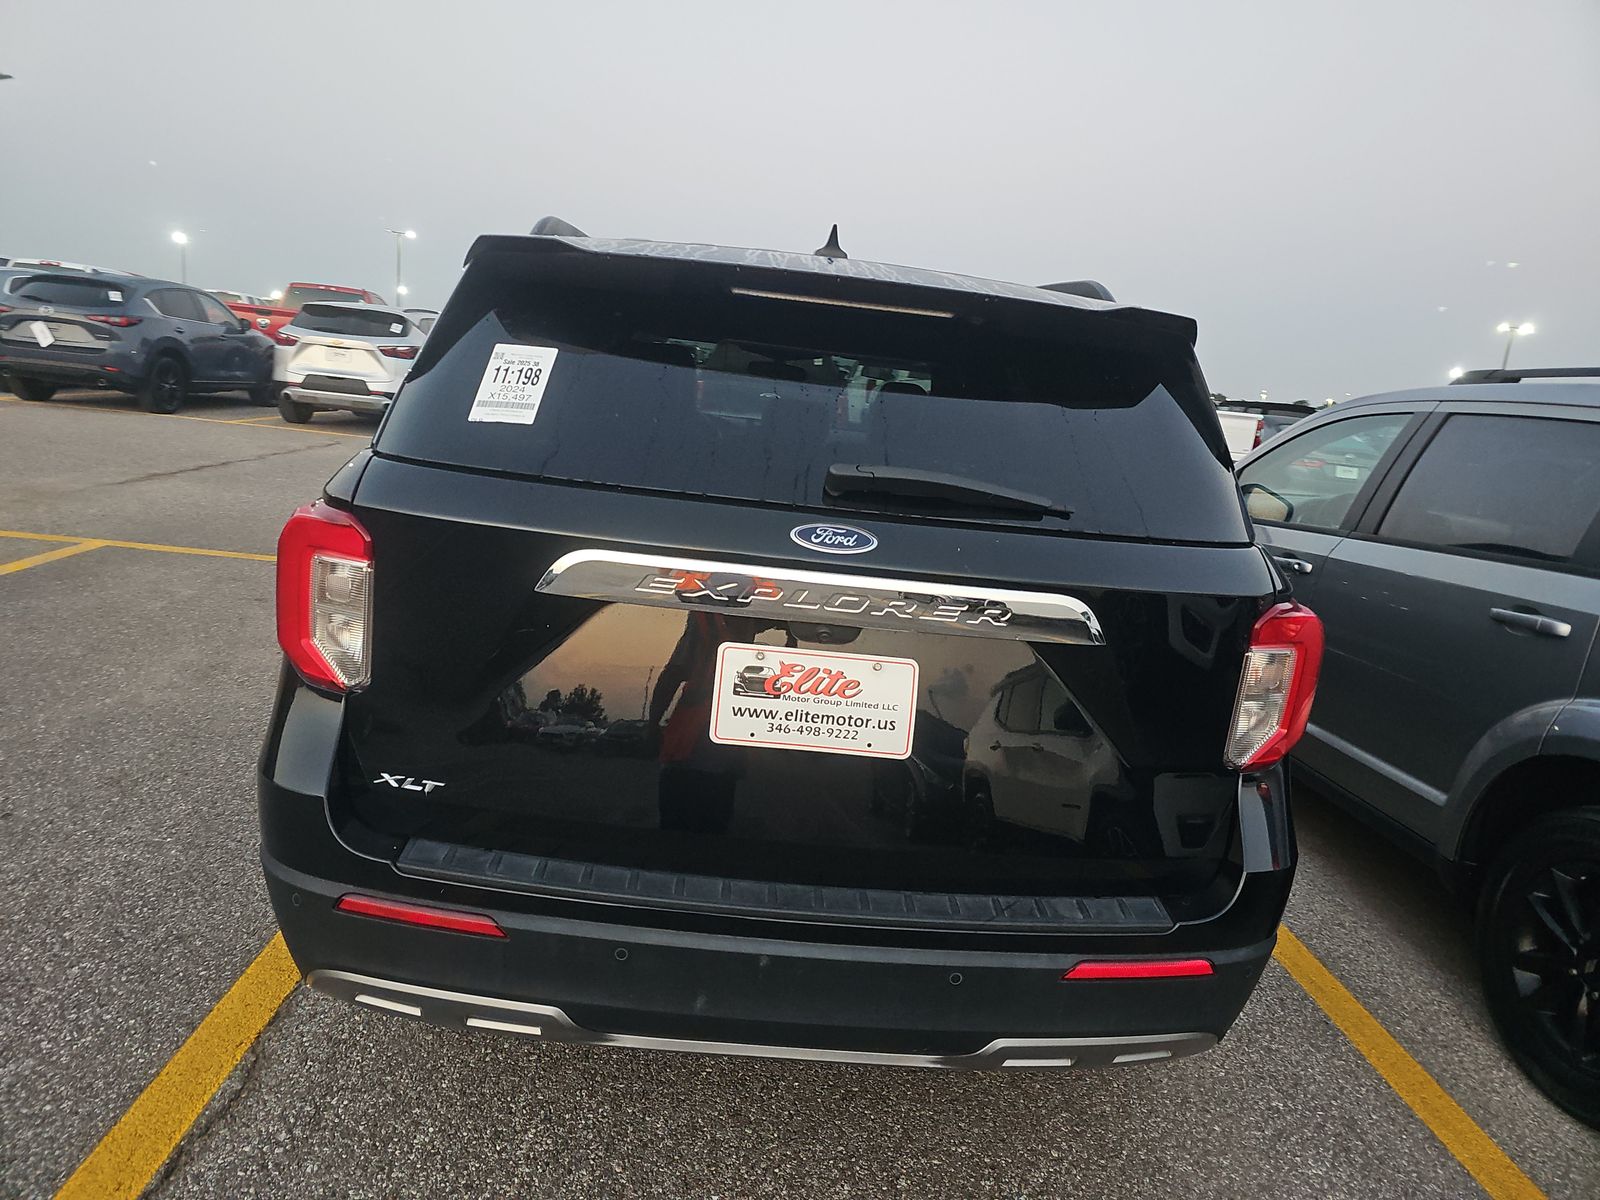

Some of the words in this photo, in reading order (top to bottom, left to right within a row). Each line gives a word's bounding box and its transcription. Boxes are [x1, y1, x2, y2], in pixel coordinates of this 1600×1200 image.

[493, 365, 542, 386] 11:198
[499, 385, 526, 393] 2024
[811, 527, 858, 546] Ford
[634, 573, 1013, 627] EXPLORER
[763, 660, 864, 700] Elite
[782, 694, 810, 704] Motor
[813, 696, 842, 707] Group
[845, 700, 879, 710] Limited
[882, 703, 899, 712] LLC
[732, 705, 896, 731] www.elitemotor.us
[767, 722, 859, 741] 346-498-9222
[373, 772, 446, 793] XLT
